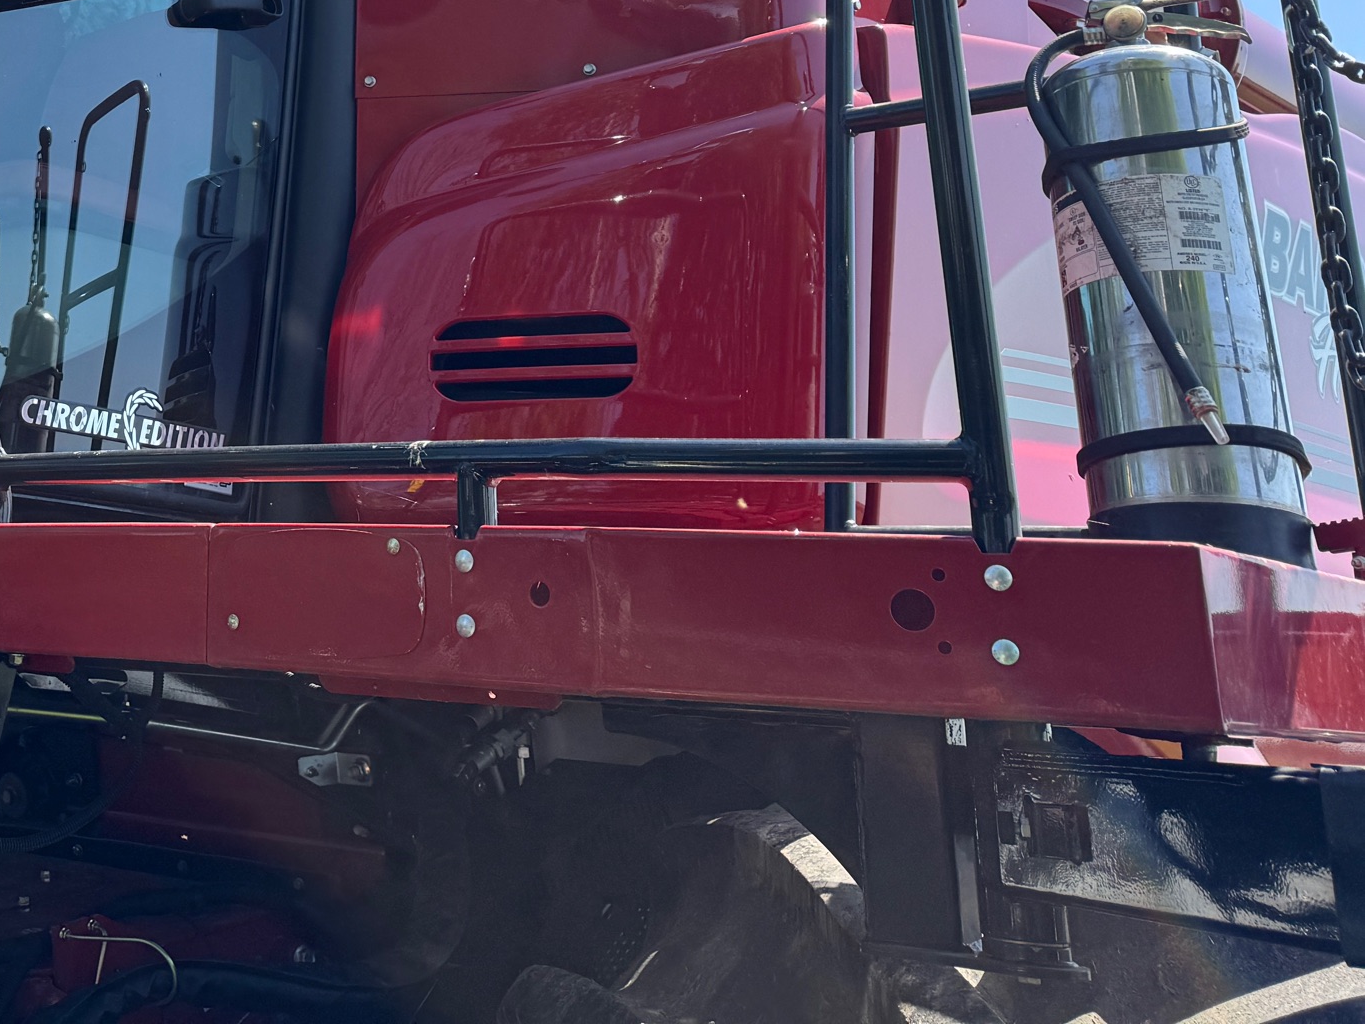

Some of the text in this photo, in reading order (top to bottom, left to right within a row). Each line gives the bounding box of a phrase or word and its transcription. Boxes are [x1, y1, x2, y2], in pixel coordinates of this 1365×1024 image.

[1262, 199, 1328, 314] BA
[21, 397, 227, 449] CHROME EDITION
